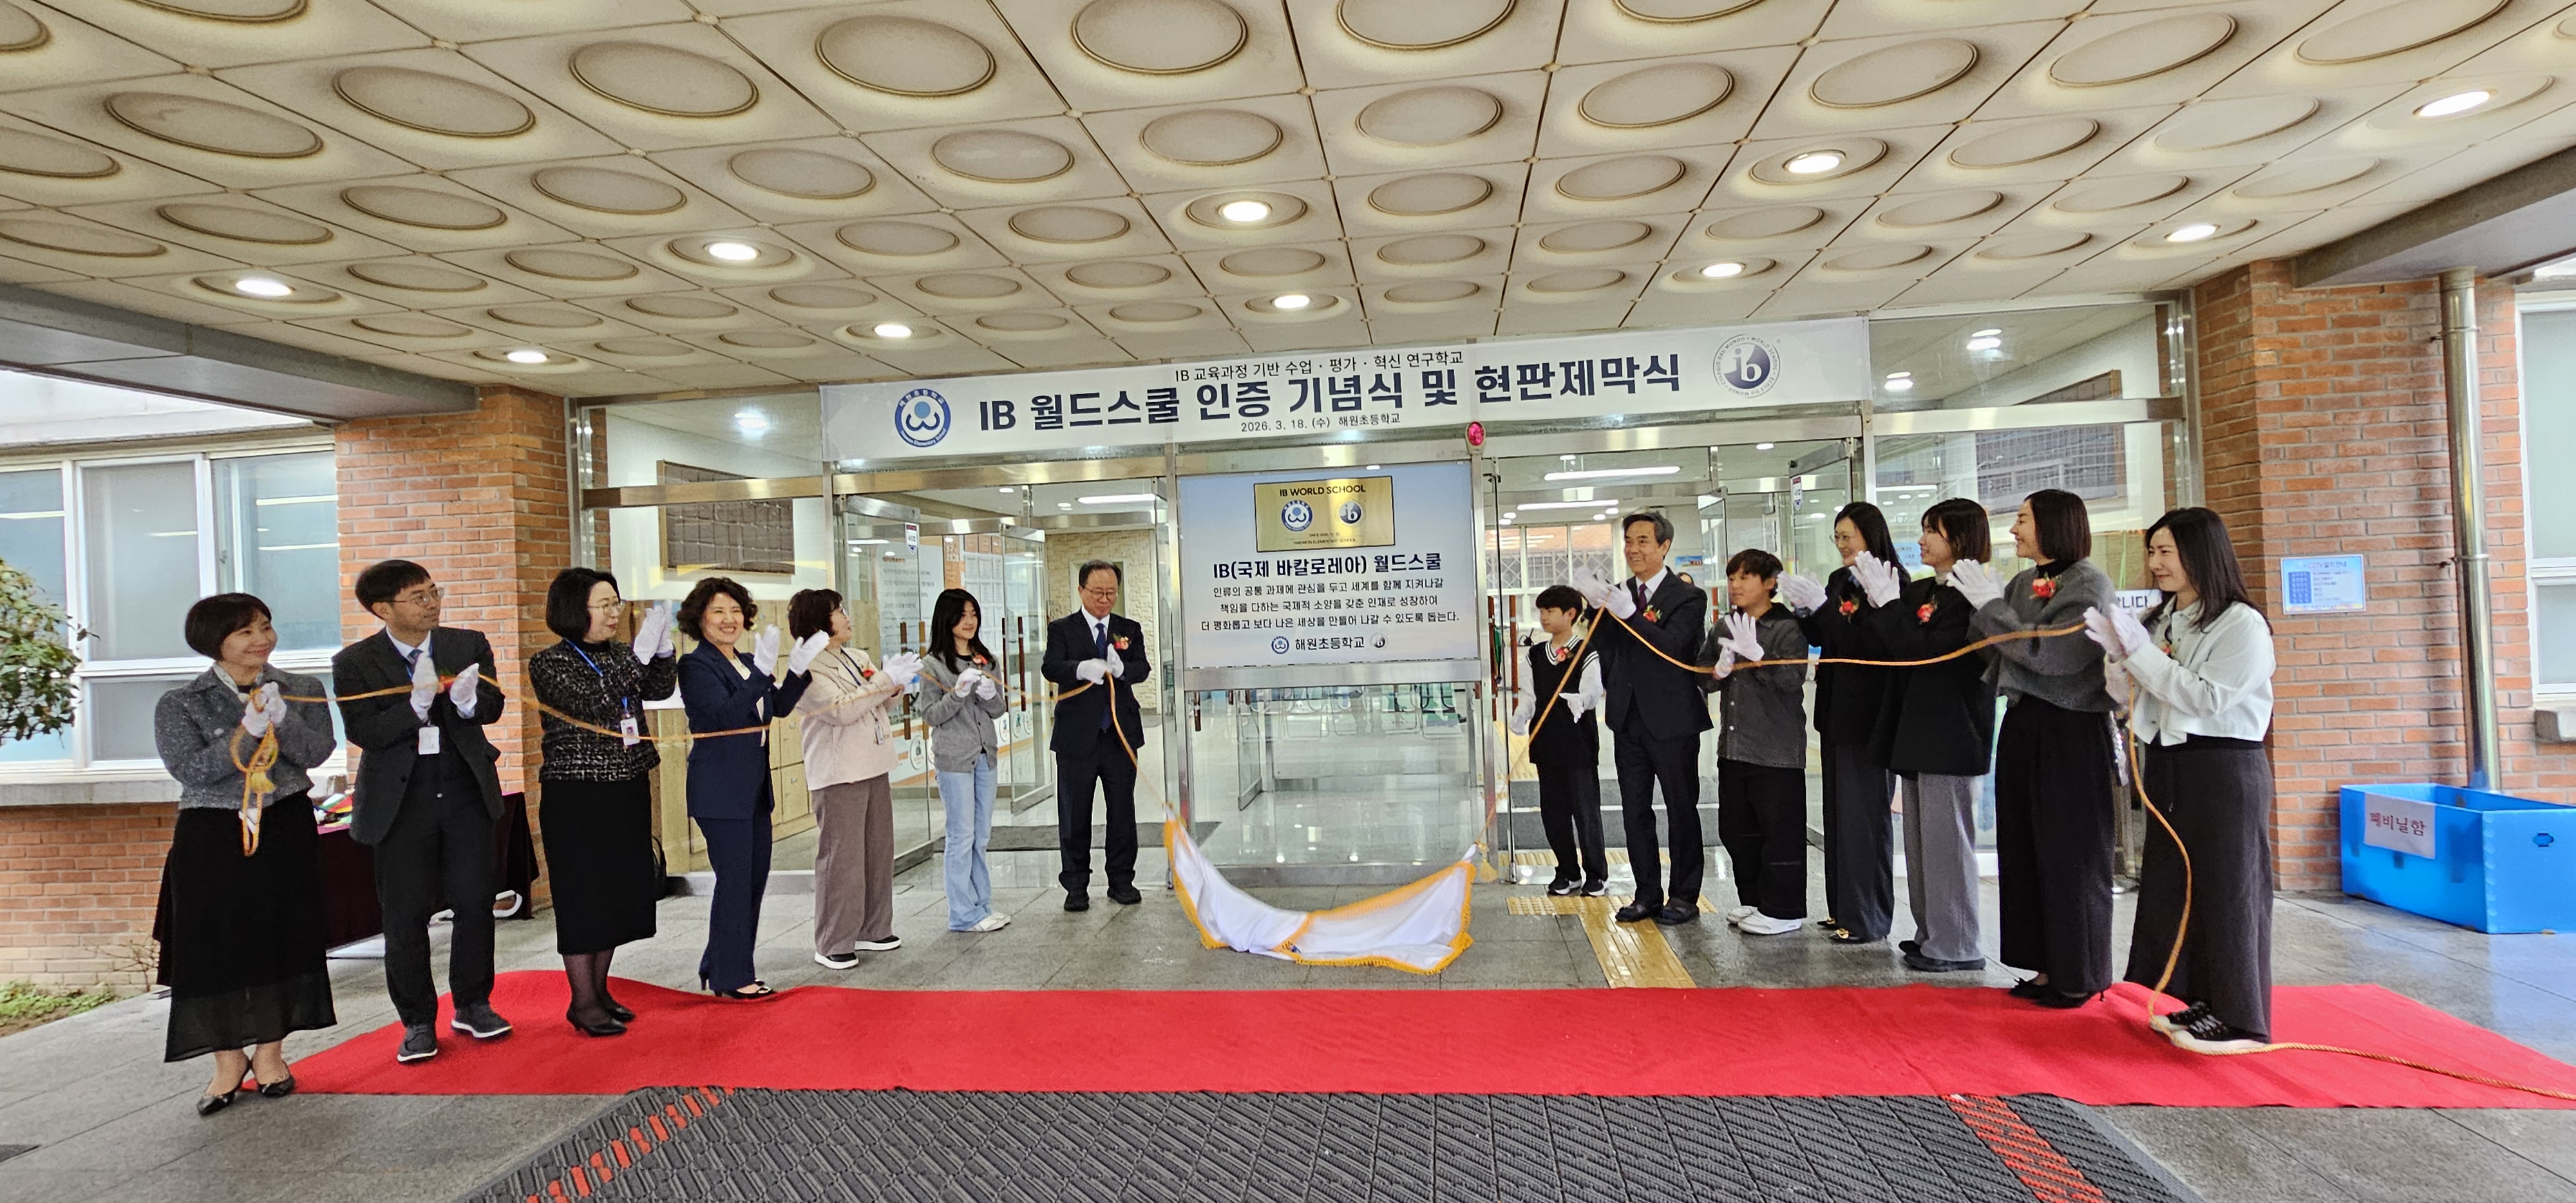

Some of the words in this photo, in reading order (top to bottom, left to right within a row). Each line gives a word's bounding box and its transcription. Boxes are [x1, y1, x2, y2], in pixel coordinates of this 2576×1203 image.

[1175, 370, 1189, 382] IB
[1194, 365, 1247, 381] 교육과정
[1253, 363, 1280, 377] 기반
[1285, 360, 1312, 375] 수업
[1329, 357, 1357, 373] 평가
[1373, 354, 1401, 370] 혁신
[1406, 352, 1464, 368] 연구학교
[980, 401, 1016, 431] IB
[1030, 387, 1180, 431] 월드스쿨
[1197, 381, 1271, 421] 인증
[1288, 372, 1403, 413] 기념식
[1421, 369, 1457, 407] 및
[1474, 354, 1680, 404] 현판제막식
[1241, 422, 1271, 432] 2026.
[1275, 421, 1286, 430] 3.
[1292, 419, 1307, 429] 18.
[1312, 417, 1331, 428] (수)
[1338, 413, 1401, 426] 해원초등학교
[1280, 489, 1288, 497] IB
[1289, 487, 1325, 497] WORLD
[1326, 484, 1366, 494] SCHOOL
[1213, 560, 1269, 580] IB(국제
[1276, 555, 1367, 576] 바칼로레아)
[1373, 553, 1441, 573] 월드스쿨
[1213, 587, 1241, 598] 인류의
[1244, 585, 1262, 596] 공통
[1266, 584, 1294, 595] 과제에
[1298, 583, 1325, 594] 관심을
[1329, 582, 1347, 592] 두고
[1351, 581, 1379, 591] 세계를
[1383, 580, 1401, 591] 함께
[1405, 578, 1443, 589] 지켜나갈
[1220, 602, 1248, 614] 책임을
[1251, 602, 1279, 612] 다하는
[1282, 600, 1310, 611] 국제적
[1314, 599, 1341, 609] 소양을
[1345, 598, 1364, 609] 갖춘
[1368, 597, 1396, 608] 인재로
[1399, 594, 1437, 606] 성장하여
[1201, 621, 1210, 631] 더
[1214, 619, 1250, 630] 평화롭고
[1254, 618, 1272, 629] 보다
[1275, 617, 1294, 628] 나은
[1297, 616, 1325, 627] 세상을
[1329, 614, 1357, 626] 만들어
[1360, 614, 1379, 625] 나갈
[1383, 614, 1392, 624] 수
[1396, 612, 1424, 623] 있도록
[1428, 611, 1459, 623] 돕는다.
[1295, 636, 1365, 650] 해원초등학교
